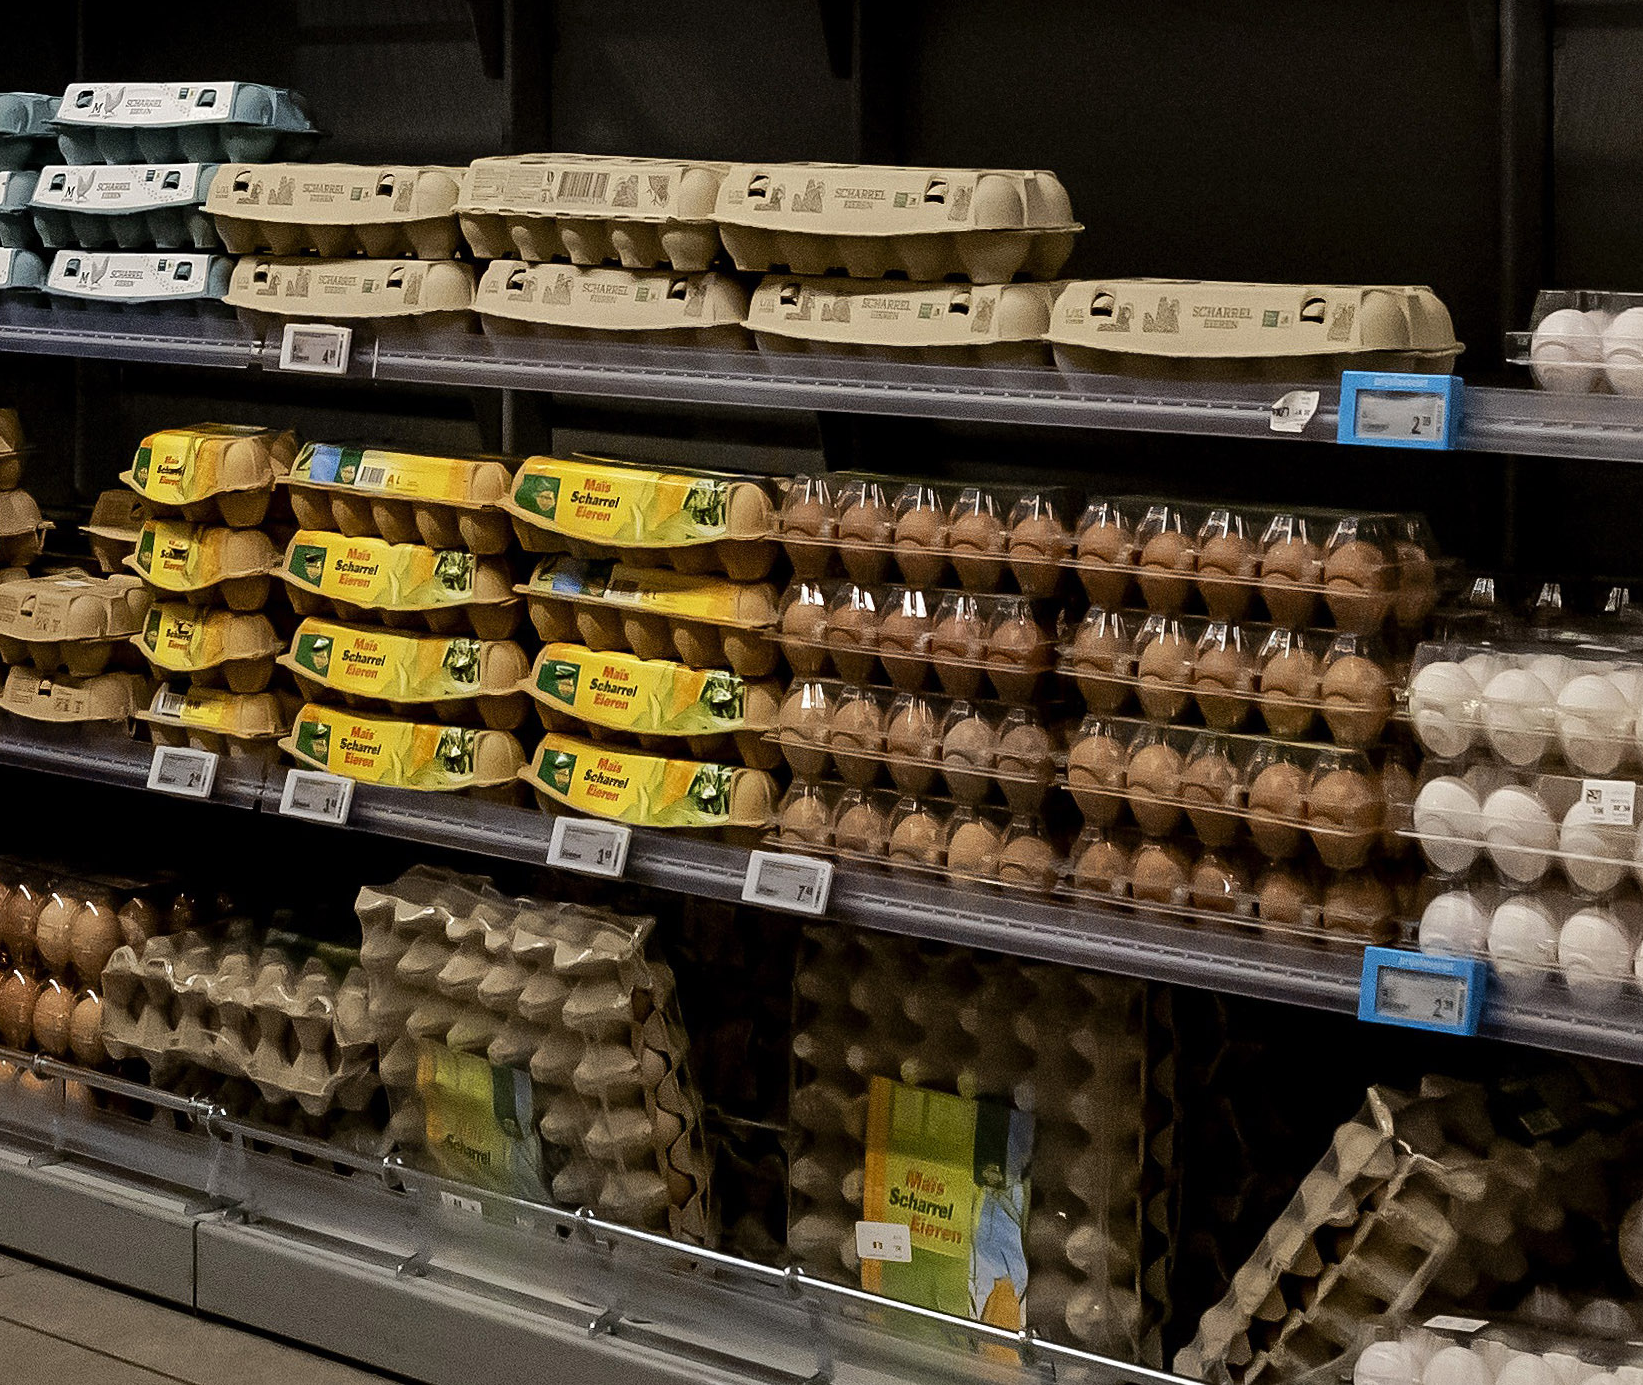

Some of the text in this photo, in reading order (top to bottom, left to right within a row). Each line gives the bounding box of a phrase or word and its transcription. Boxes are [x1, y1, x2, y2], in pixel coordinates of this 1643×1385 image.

[834, 188, 886, 202] SCHARREL
[582, 283, 629, 297] SCHARREL
[861, 297, 911, 312] SCHARREL
[1192, 306, 1253, 320] SCHARREL
[571, 491, 620, 508] Scharrel
[575, 507, 611, 521] Eieren
[335, 560, 379, 576] Scharrel
[339, 575, 371, 588] Eieren
[342, 650, 385, 666] Scharrel
[346, 664, 378, 678] Eieren
[590, 679, 638, 697] Scharrel
[593, 695, 629, 710] Eieren
[340, 739, 382, 755] Scharrel
[343, 753, 374, 767] Eieren
[584, 771, 629, 788] Scharrel
[586, 786, 619, 801] Eieren
[889, 1188, 954, 1220] Scharrel
[911, 1217, 962, 1244] Eieren
